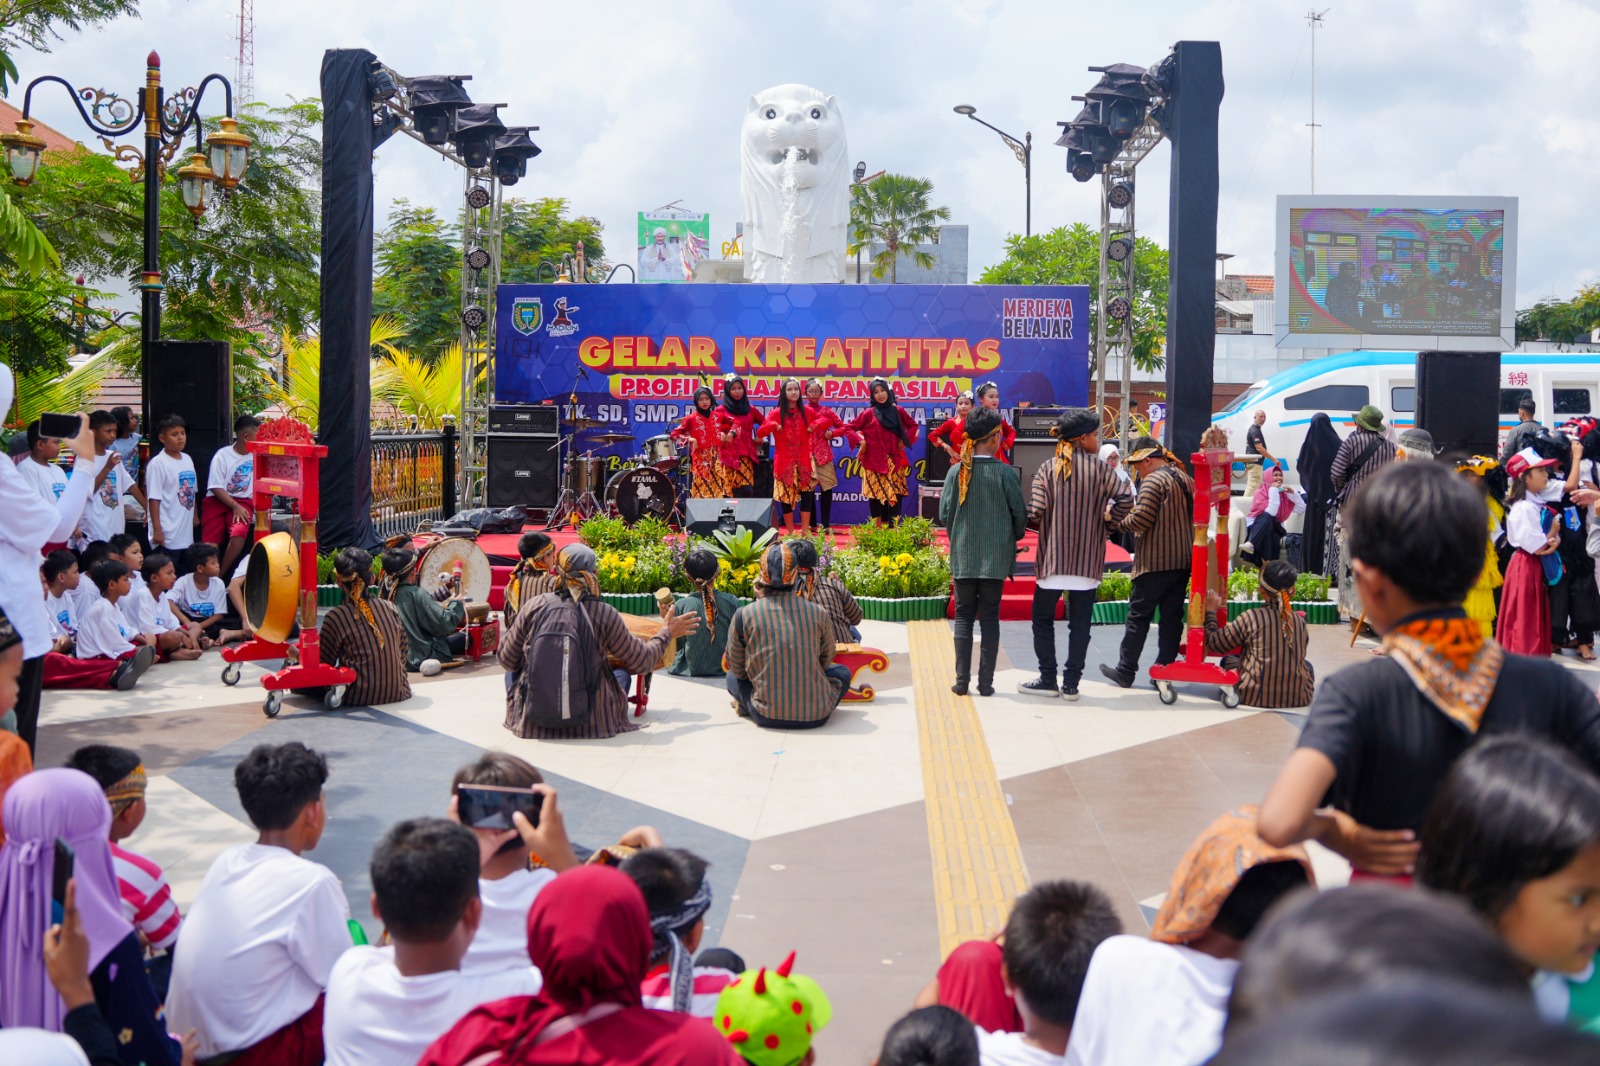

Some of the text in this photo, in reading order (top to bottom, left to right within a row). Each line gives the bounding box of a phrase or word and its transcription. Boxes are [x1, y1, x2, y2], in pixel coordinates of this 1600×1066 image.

[1003, 298, 1072, 318] MERDEKA
[1003, 318, 1072, 339] BELAJAR
[578, 335, 1002, 370] GELAR KREATIFITAS
[713, 378, 806, 398] PLAJ
[824, 378, 958, 399] PANASILA
[597, 404, 628, 425] SD,
[634, 404, 679, 422] SMP
